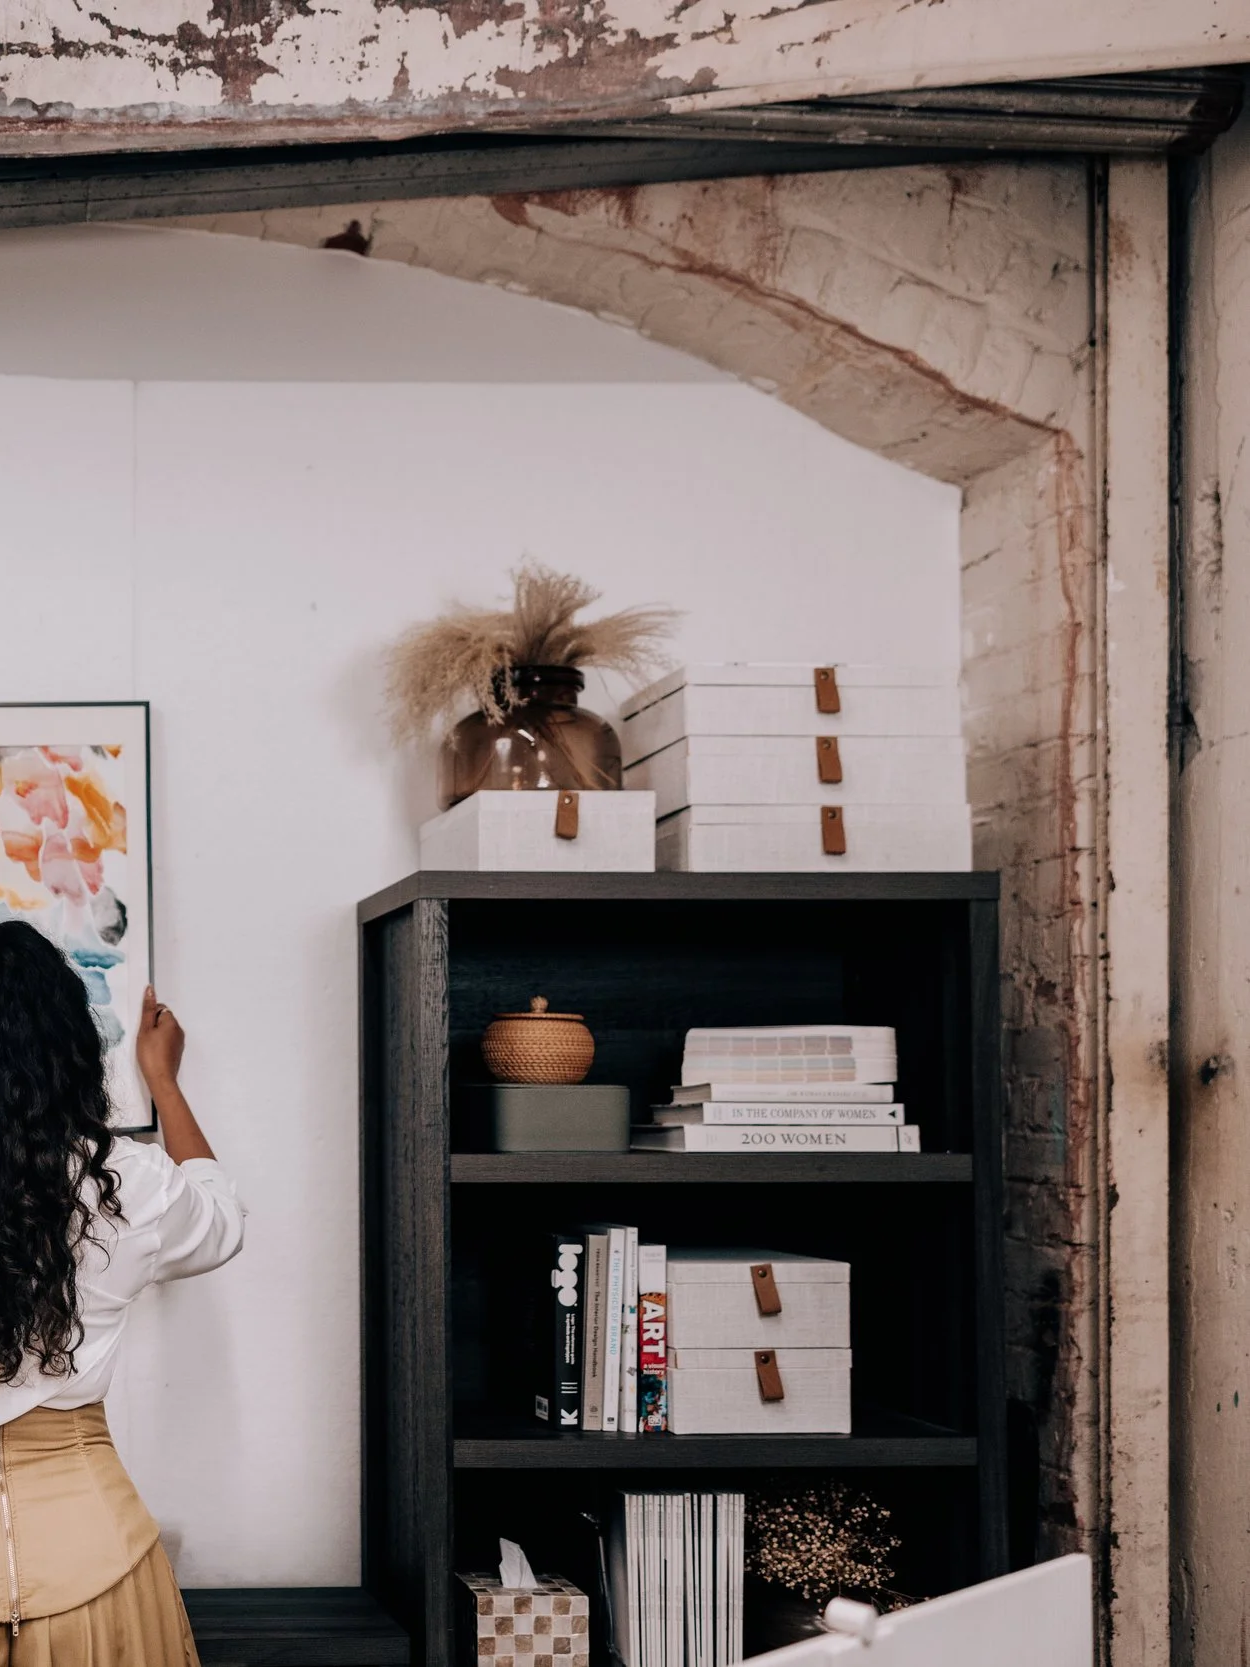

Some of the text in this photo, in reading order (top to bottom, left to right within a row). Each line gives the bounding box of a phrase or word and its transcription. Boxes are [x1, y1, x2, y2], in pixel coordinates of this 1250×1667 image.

[732, 1108, 744, 1119] IN
[746, 1108, 768, 1119] THE
[770, 1108, 819, 1119] COMPANY
[821, 1108, 836, 1119] OF
[838, 1108, 876, 1119] WOMEN
[741, 1133, 847, 1145] 200 WOMEN
[611, 1312, 618, 1322] OF
[642, 1300, 665, 1358] ART
[610, 1325, 618, 1355] BRAND
